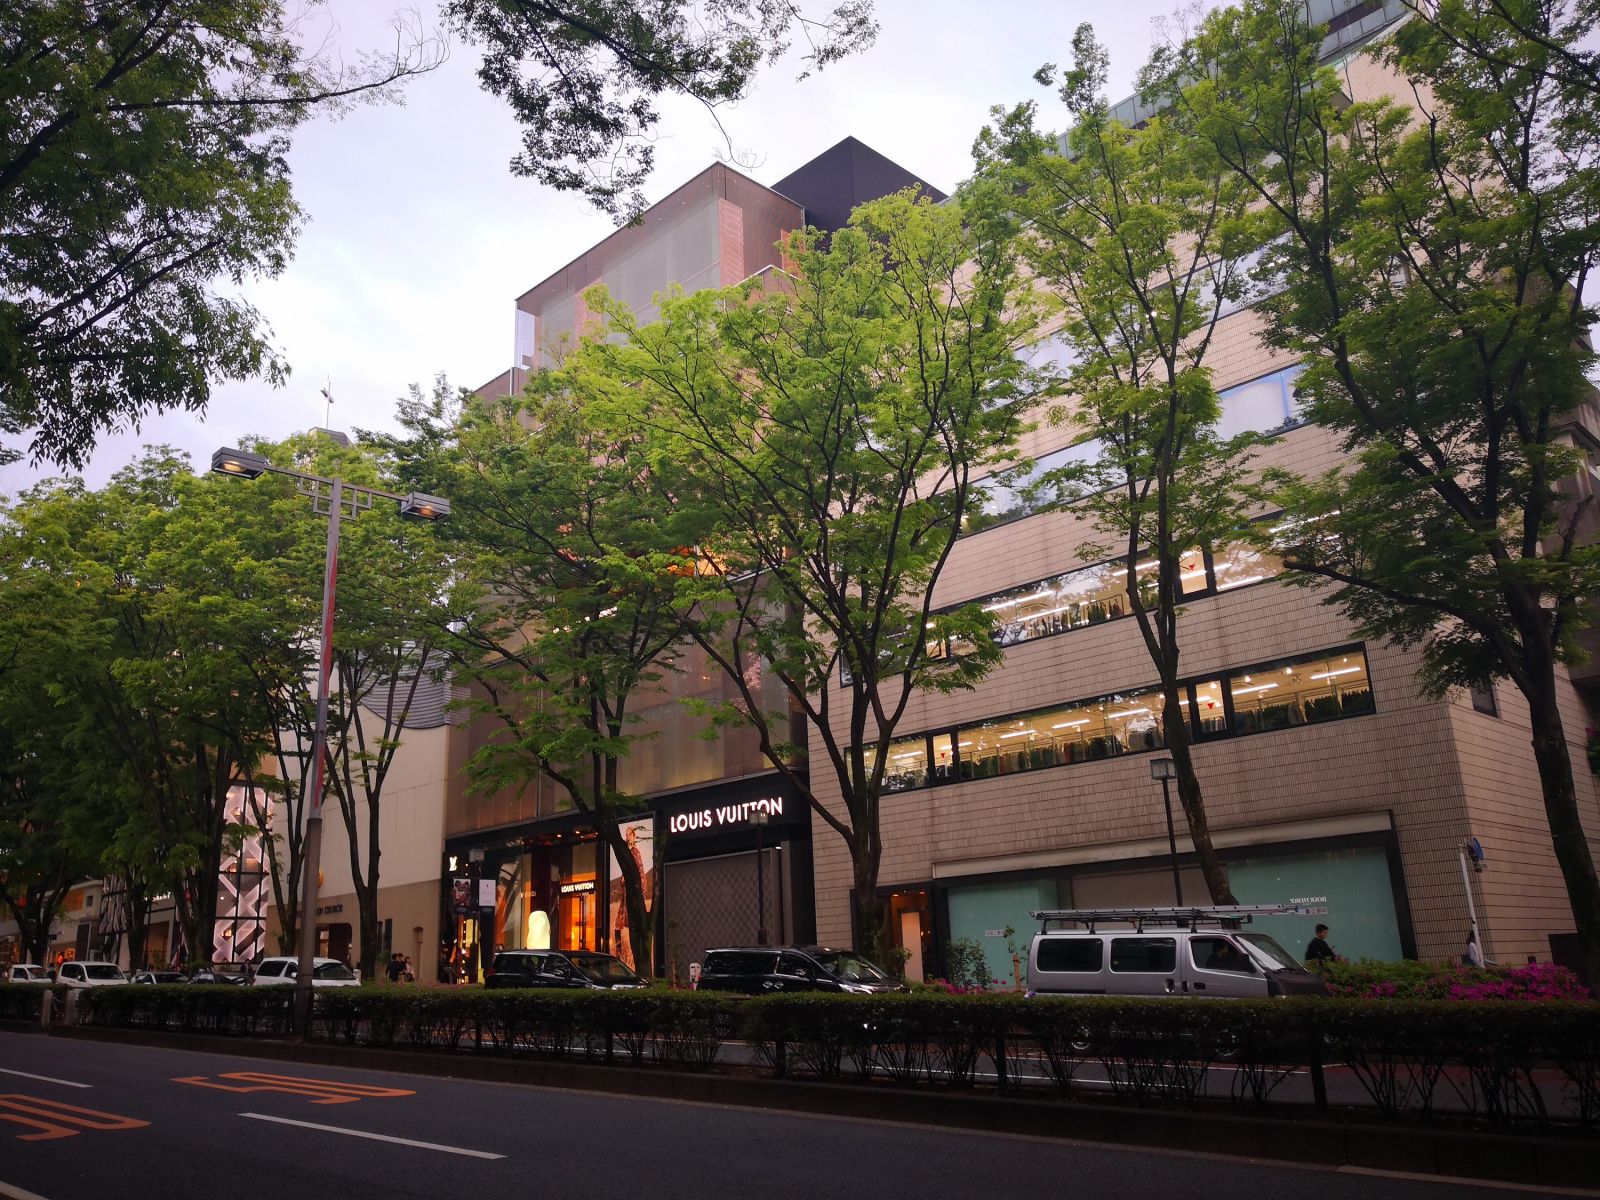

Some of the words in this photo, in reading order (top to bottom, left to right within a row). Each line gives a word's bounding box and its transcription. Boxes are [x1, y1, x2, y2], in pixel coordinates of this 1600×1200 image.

[670, 809, 712, 833] LOUIS
[716, 796, 783, 825] VUITTON
[561, 884, 575, 893] LOUIS
